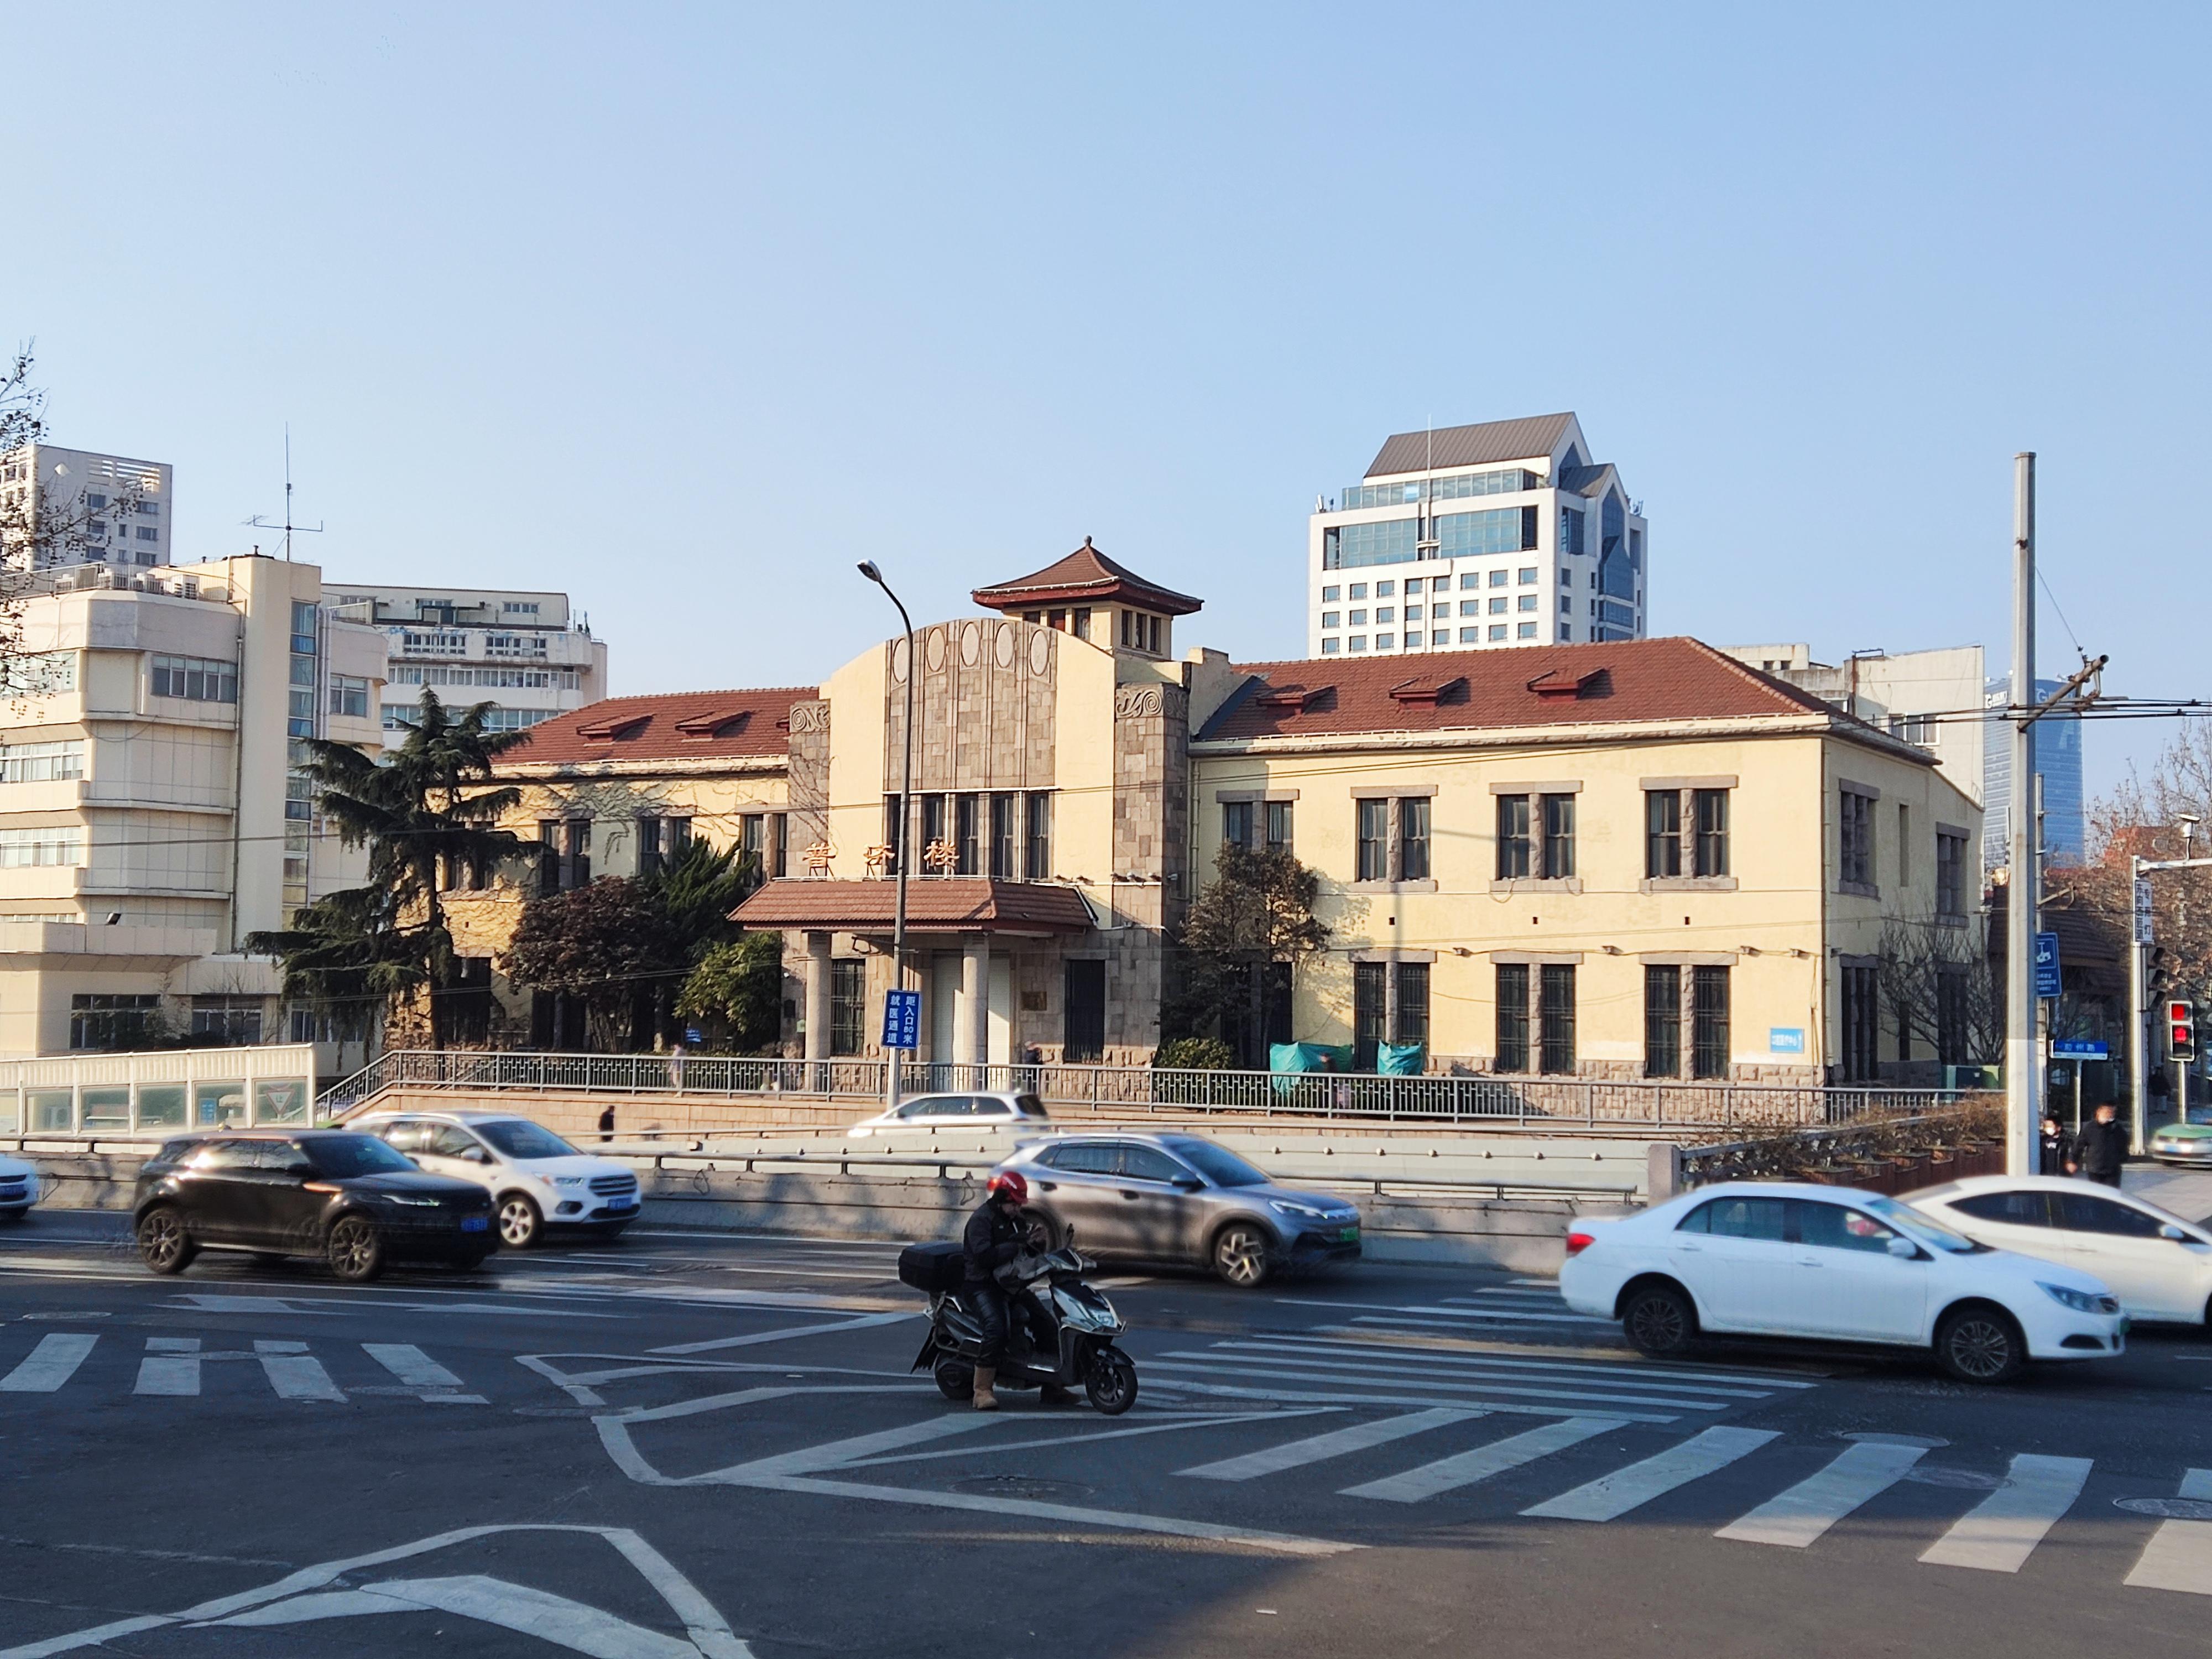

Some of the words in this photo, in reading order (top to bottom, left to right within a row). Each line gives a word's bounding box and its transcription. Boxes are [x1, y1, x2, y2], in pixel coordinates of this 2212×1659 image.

[887, 994, 900, 1044] 就医通道
[902, 995, 916, 1045] 距入口80米
